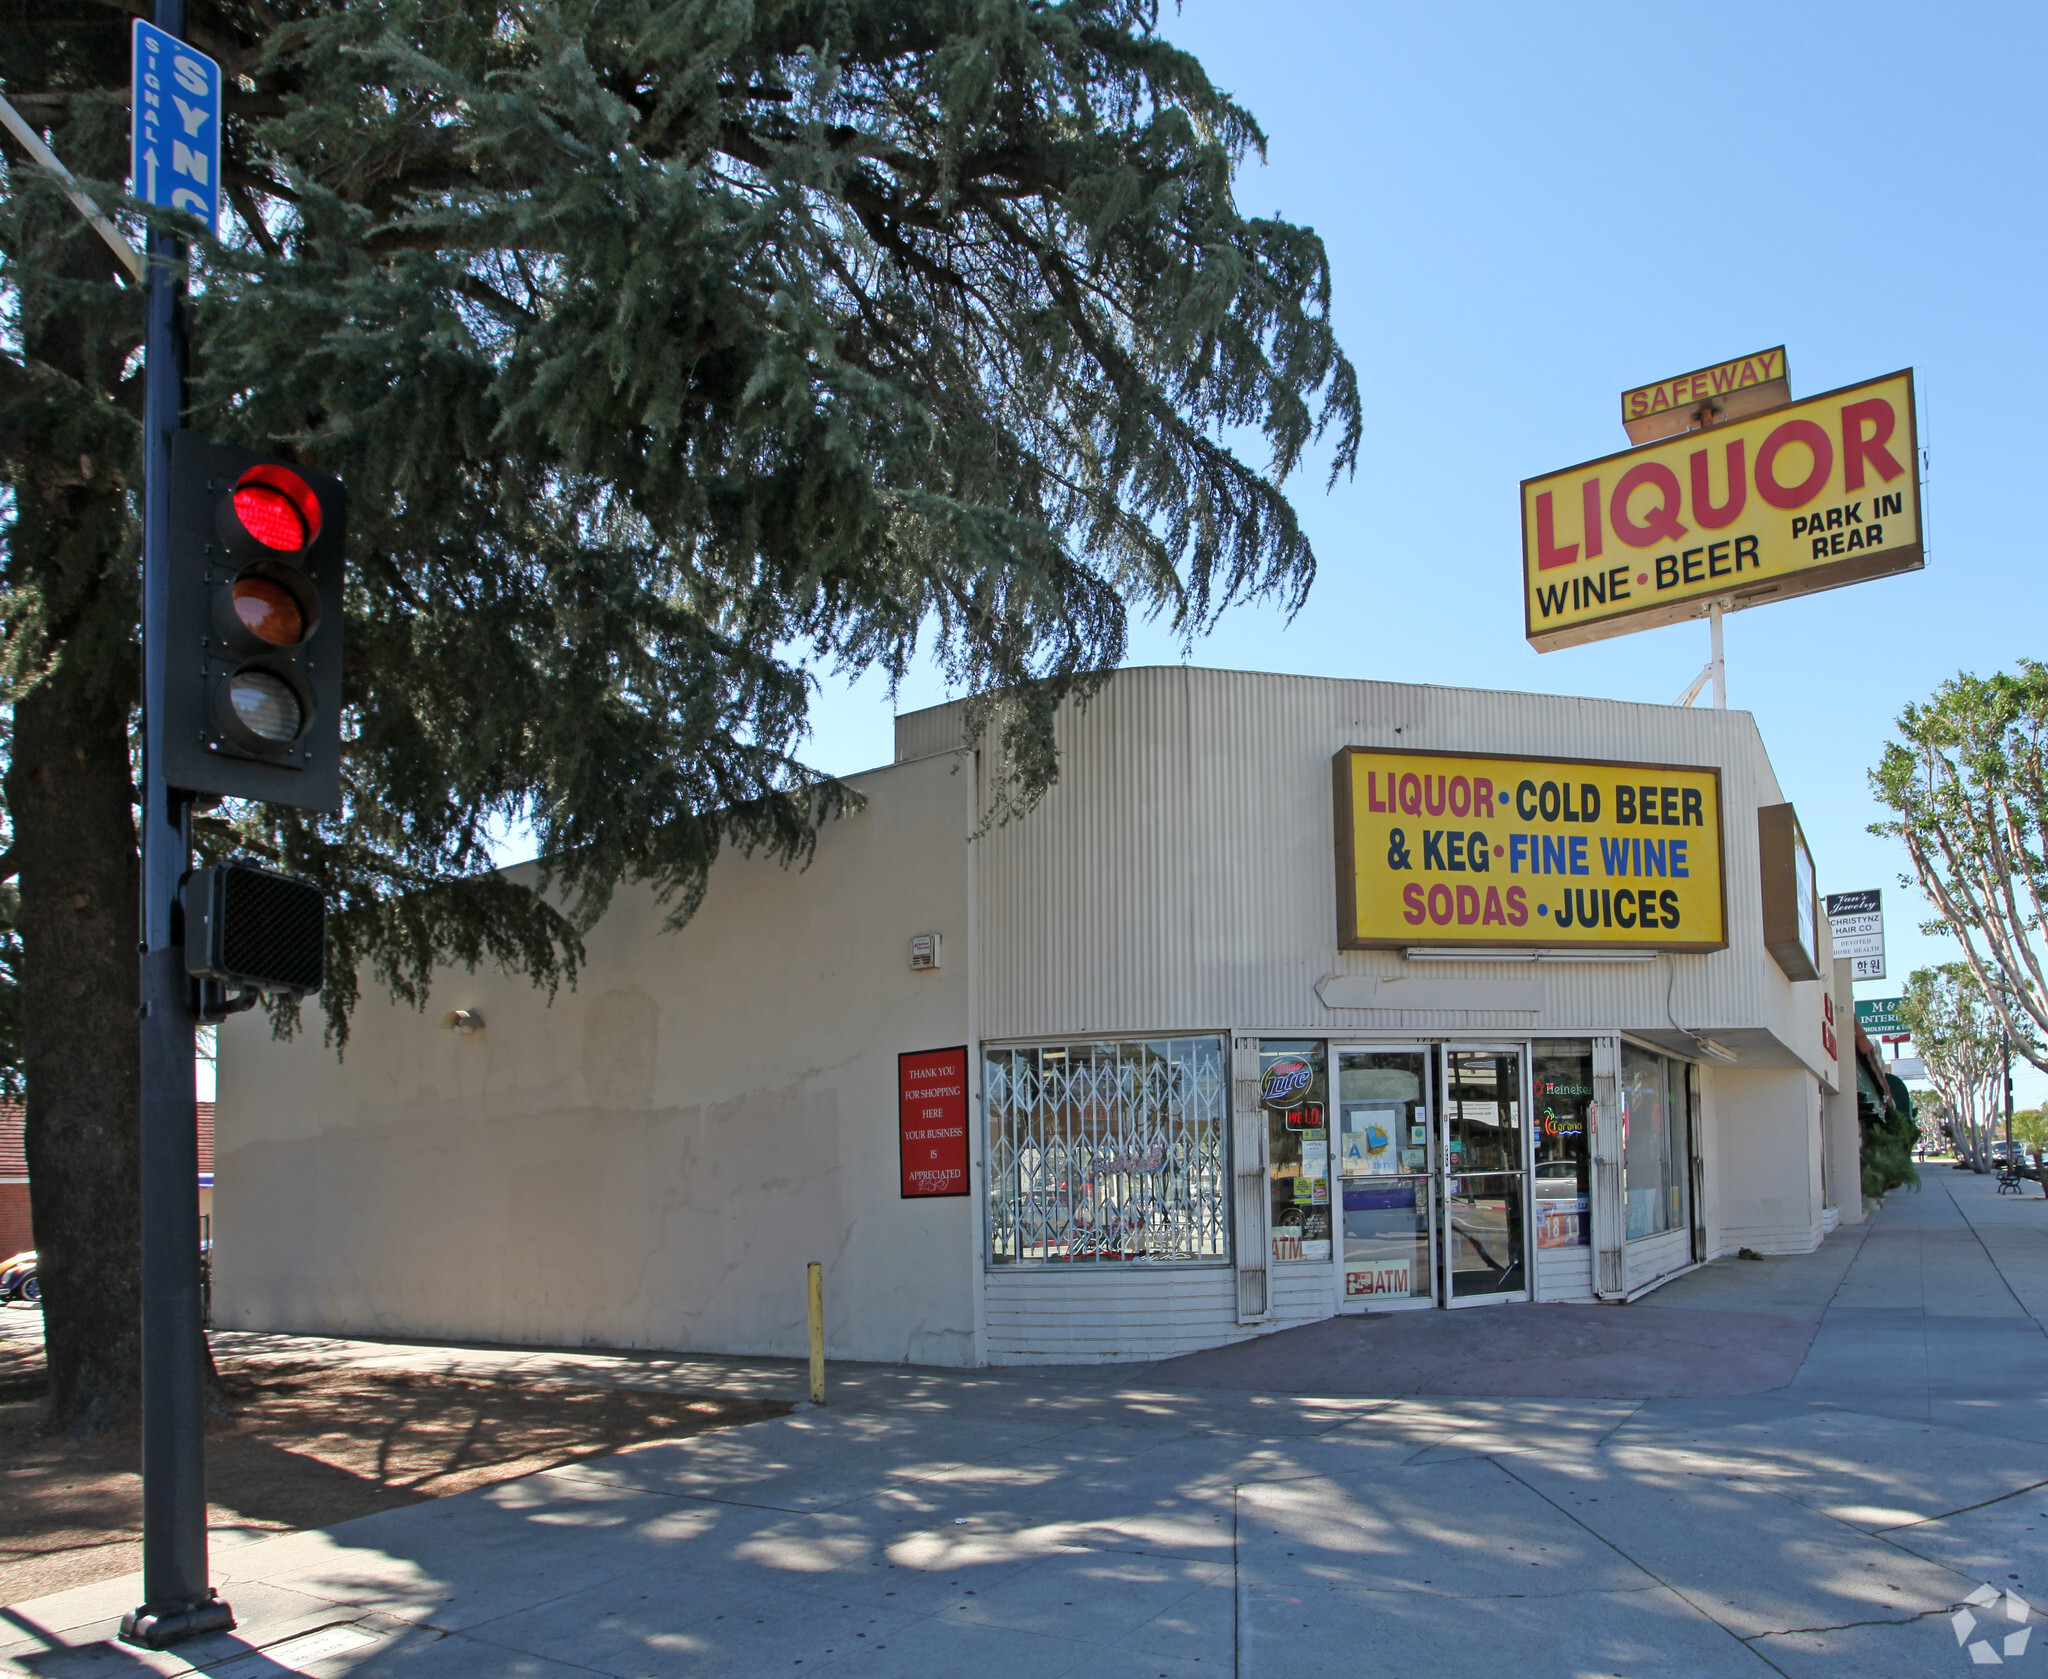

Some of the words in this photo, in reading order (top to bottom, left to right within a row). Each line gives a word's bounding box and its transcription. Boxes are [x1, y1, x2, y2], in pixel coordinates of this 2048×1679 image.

[144, 36, 161, 143] SIGNAL
[1630, 352, 1778, 416] SAFEWAY
[1535, 397, 1906, 572] LIQUOR
[1792, 500, 1863, 539] PARK
[1874, 492, 1903, 519] IN
[1812, 523, 1883, 559] REAR
[1536, 565, 1632, 618] WINE
[1655, 534, 1761, 590] BEER
[1367, 770, 1495, 819] LIQUOR
[1516, 779, 1601, 823] COLD
[1615, 784, 1704, 826] BEER
[1387, 827, 1413, 870] &
[1423, 829, 1490, 873] KEG
[1509, 833, 1590, 876] FINE
[1599, 836, 1690, 878] WINE
[1837, 893, 1869, 903] Van's
[1402, 882, 1529, 927] SODAS
[1554, 888, 1681, 930] JUICES
[1829, 900, 1878, 915] Jewelry
[1830, 914, 1880, 927] CHRISTYNZ
[1835, 926, 1857, 935] HAIR
[1858, 924, 1875, 932] CO.
[1840, 938, 1872, 947] DEVOTED
[1853, 946, 1880, 954] HEALTH
[1872, 1002, 1883, 1013] M
[1886, 1001, 1896, 1011] &
[1860, 1014, 1900, 1024] INTERI
[909, 1068, 937, 1080] THANK
[938, 1066, 956, 1077] YOU
[905, 1089, 920, 1100] FOR
[920, 1086, 961, 1099] SHOPPING
[922, 1108, 943, 1119] HERE
[1288, 1111, 1302, 1125] WE
[904, 1129, 926, 1141] YOUR
[927, 1127, 963, 1139] BUSINESS
[930, 1149, 938, 1159] IS
[1349, 1143, 1362, 1159] A
[909, 1169, 961, 1181] APPRECIATED
[1271, 1236, 1302, 1260] ATM
[1374, 1268, 1408, 1294] ATM
